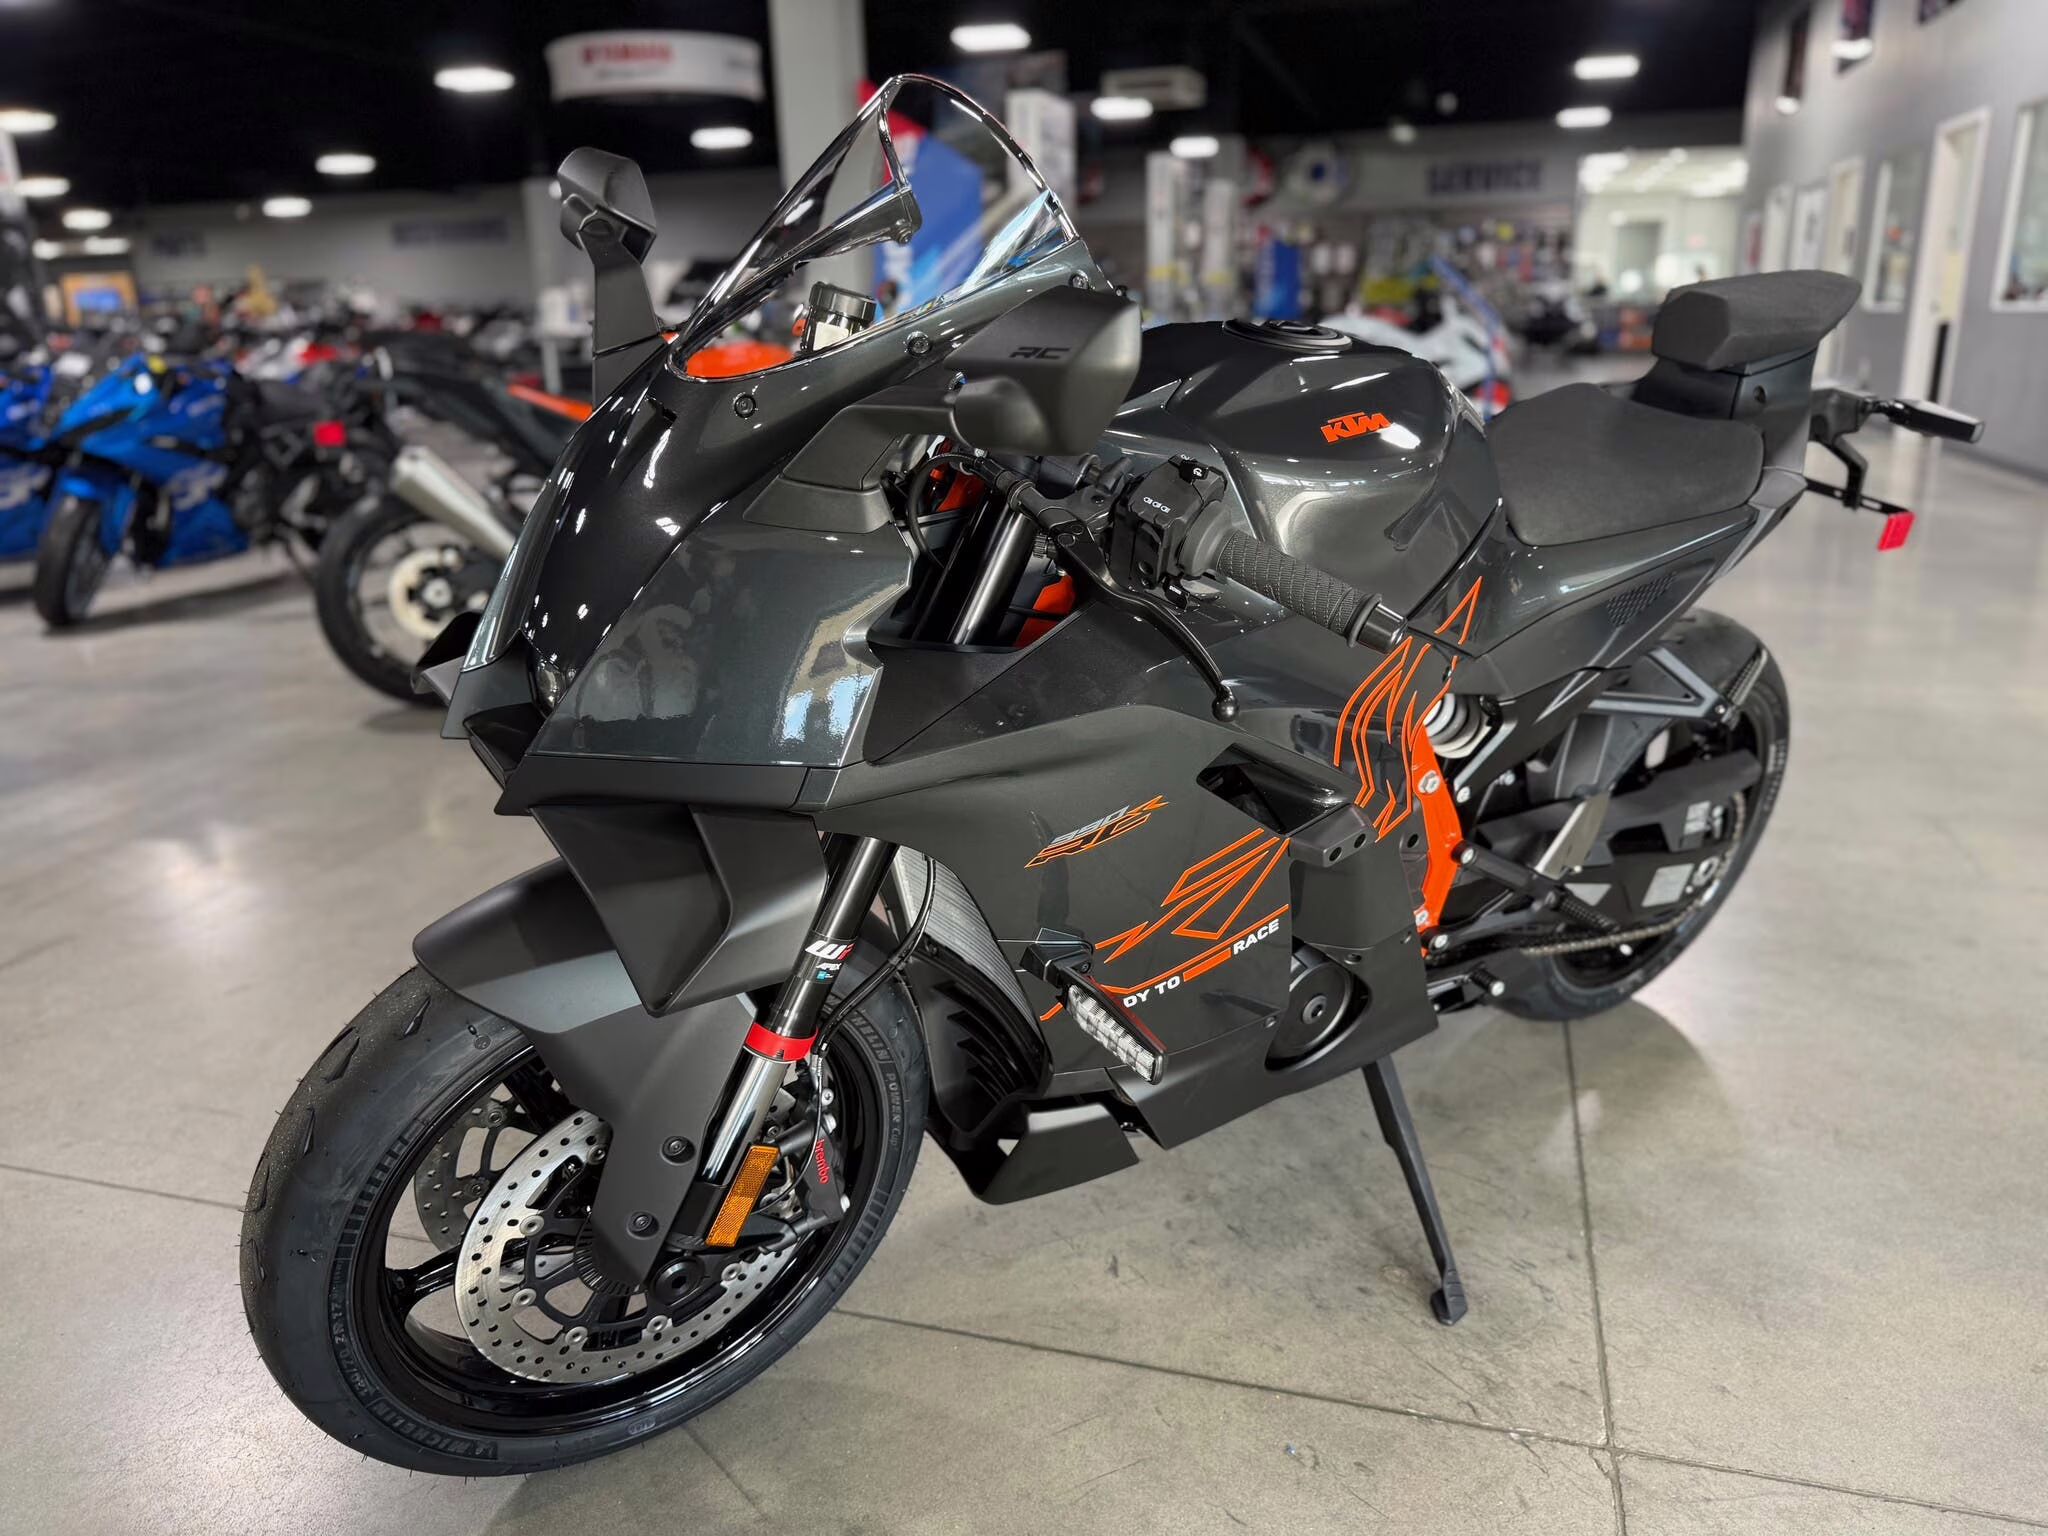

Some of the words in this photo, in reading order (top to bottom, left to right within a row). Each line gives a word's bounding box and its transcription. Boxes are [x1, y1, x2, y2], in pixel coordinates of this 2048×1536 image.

[1320, 412, 1392, 443] KTM
[1154, 975, 1181, 995] TO
[1233, 918, 1280, 955] RACE
[885, 1072, 900, 1122] POWER
[814, 1138, 830, 1185] brembo
[370, 1401, 468, 1454] MICHELIN
